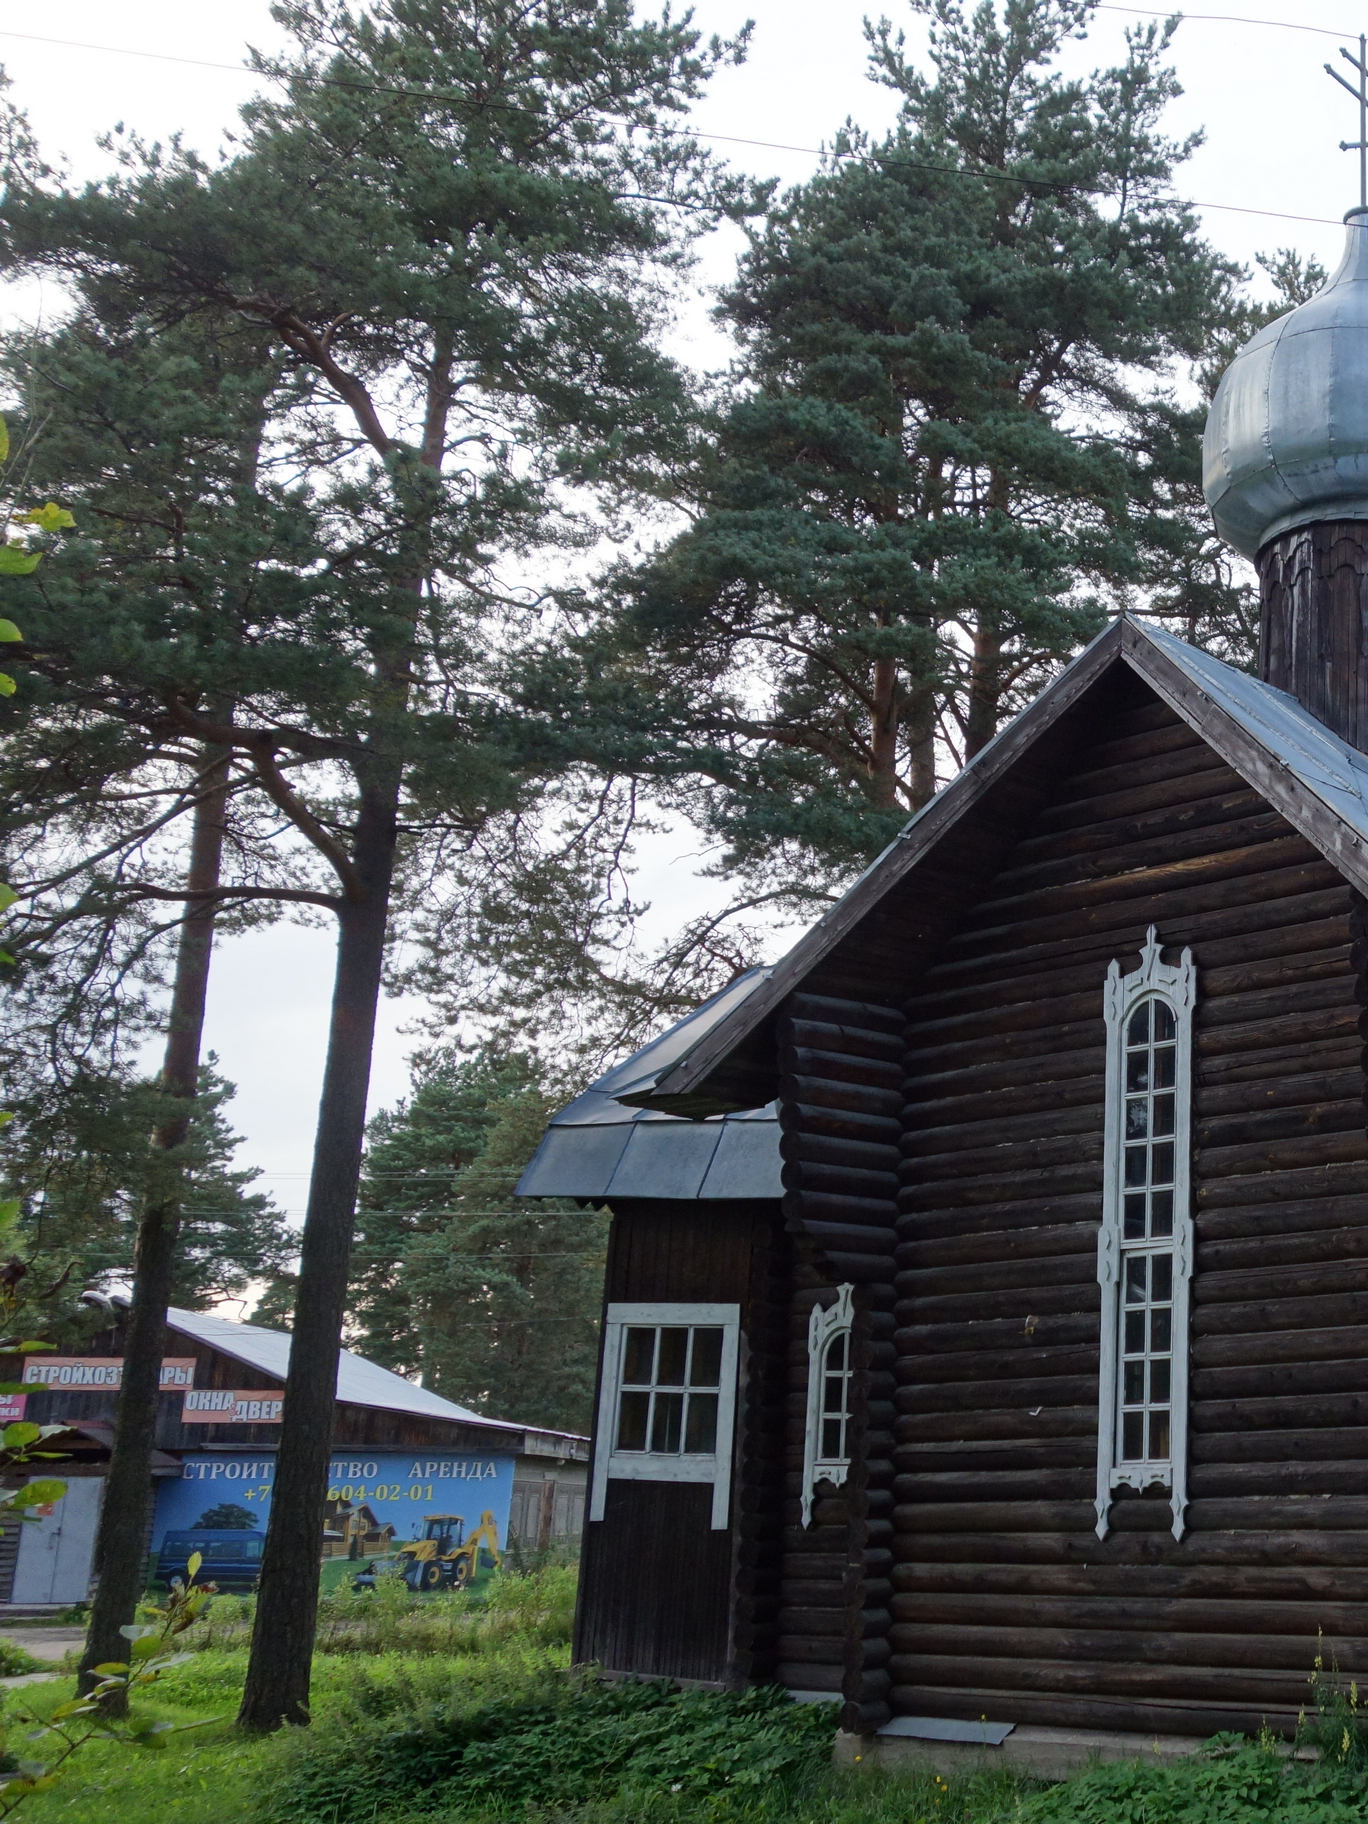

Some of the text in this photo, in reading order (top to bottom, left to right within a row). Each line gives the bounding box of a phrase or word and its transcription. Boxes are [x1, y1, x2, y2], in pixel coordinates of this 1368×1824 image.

[25, 1362, 194, 1385] СТРОЙХОЗРЫ
[185, 1391, 234, 1410] ОКНА
[231, 1400, 283, 1422] ДВЕР
[182, 1461, 497, 1481] СТРОИТТВО АРЕНДА
